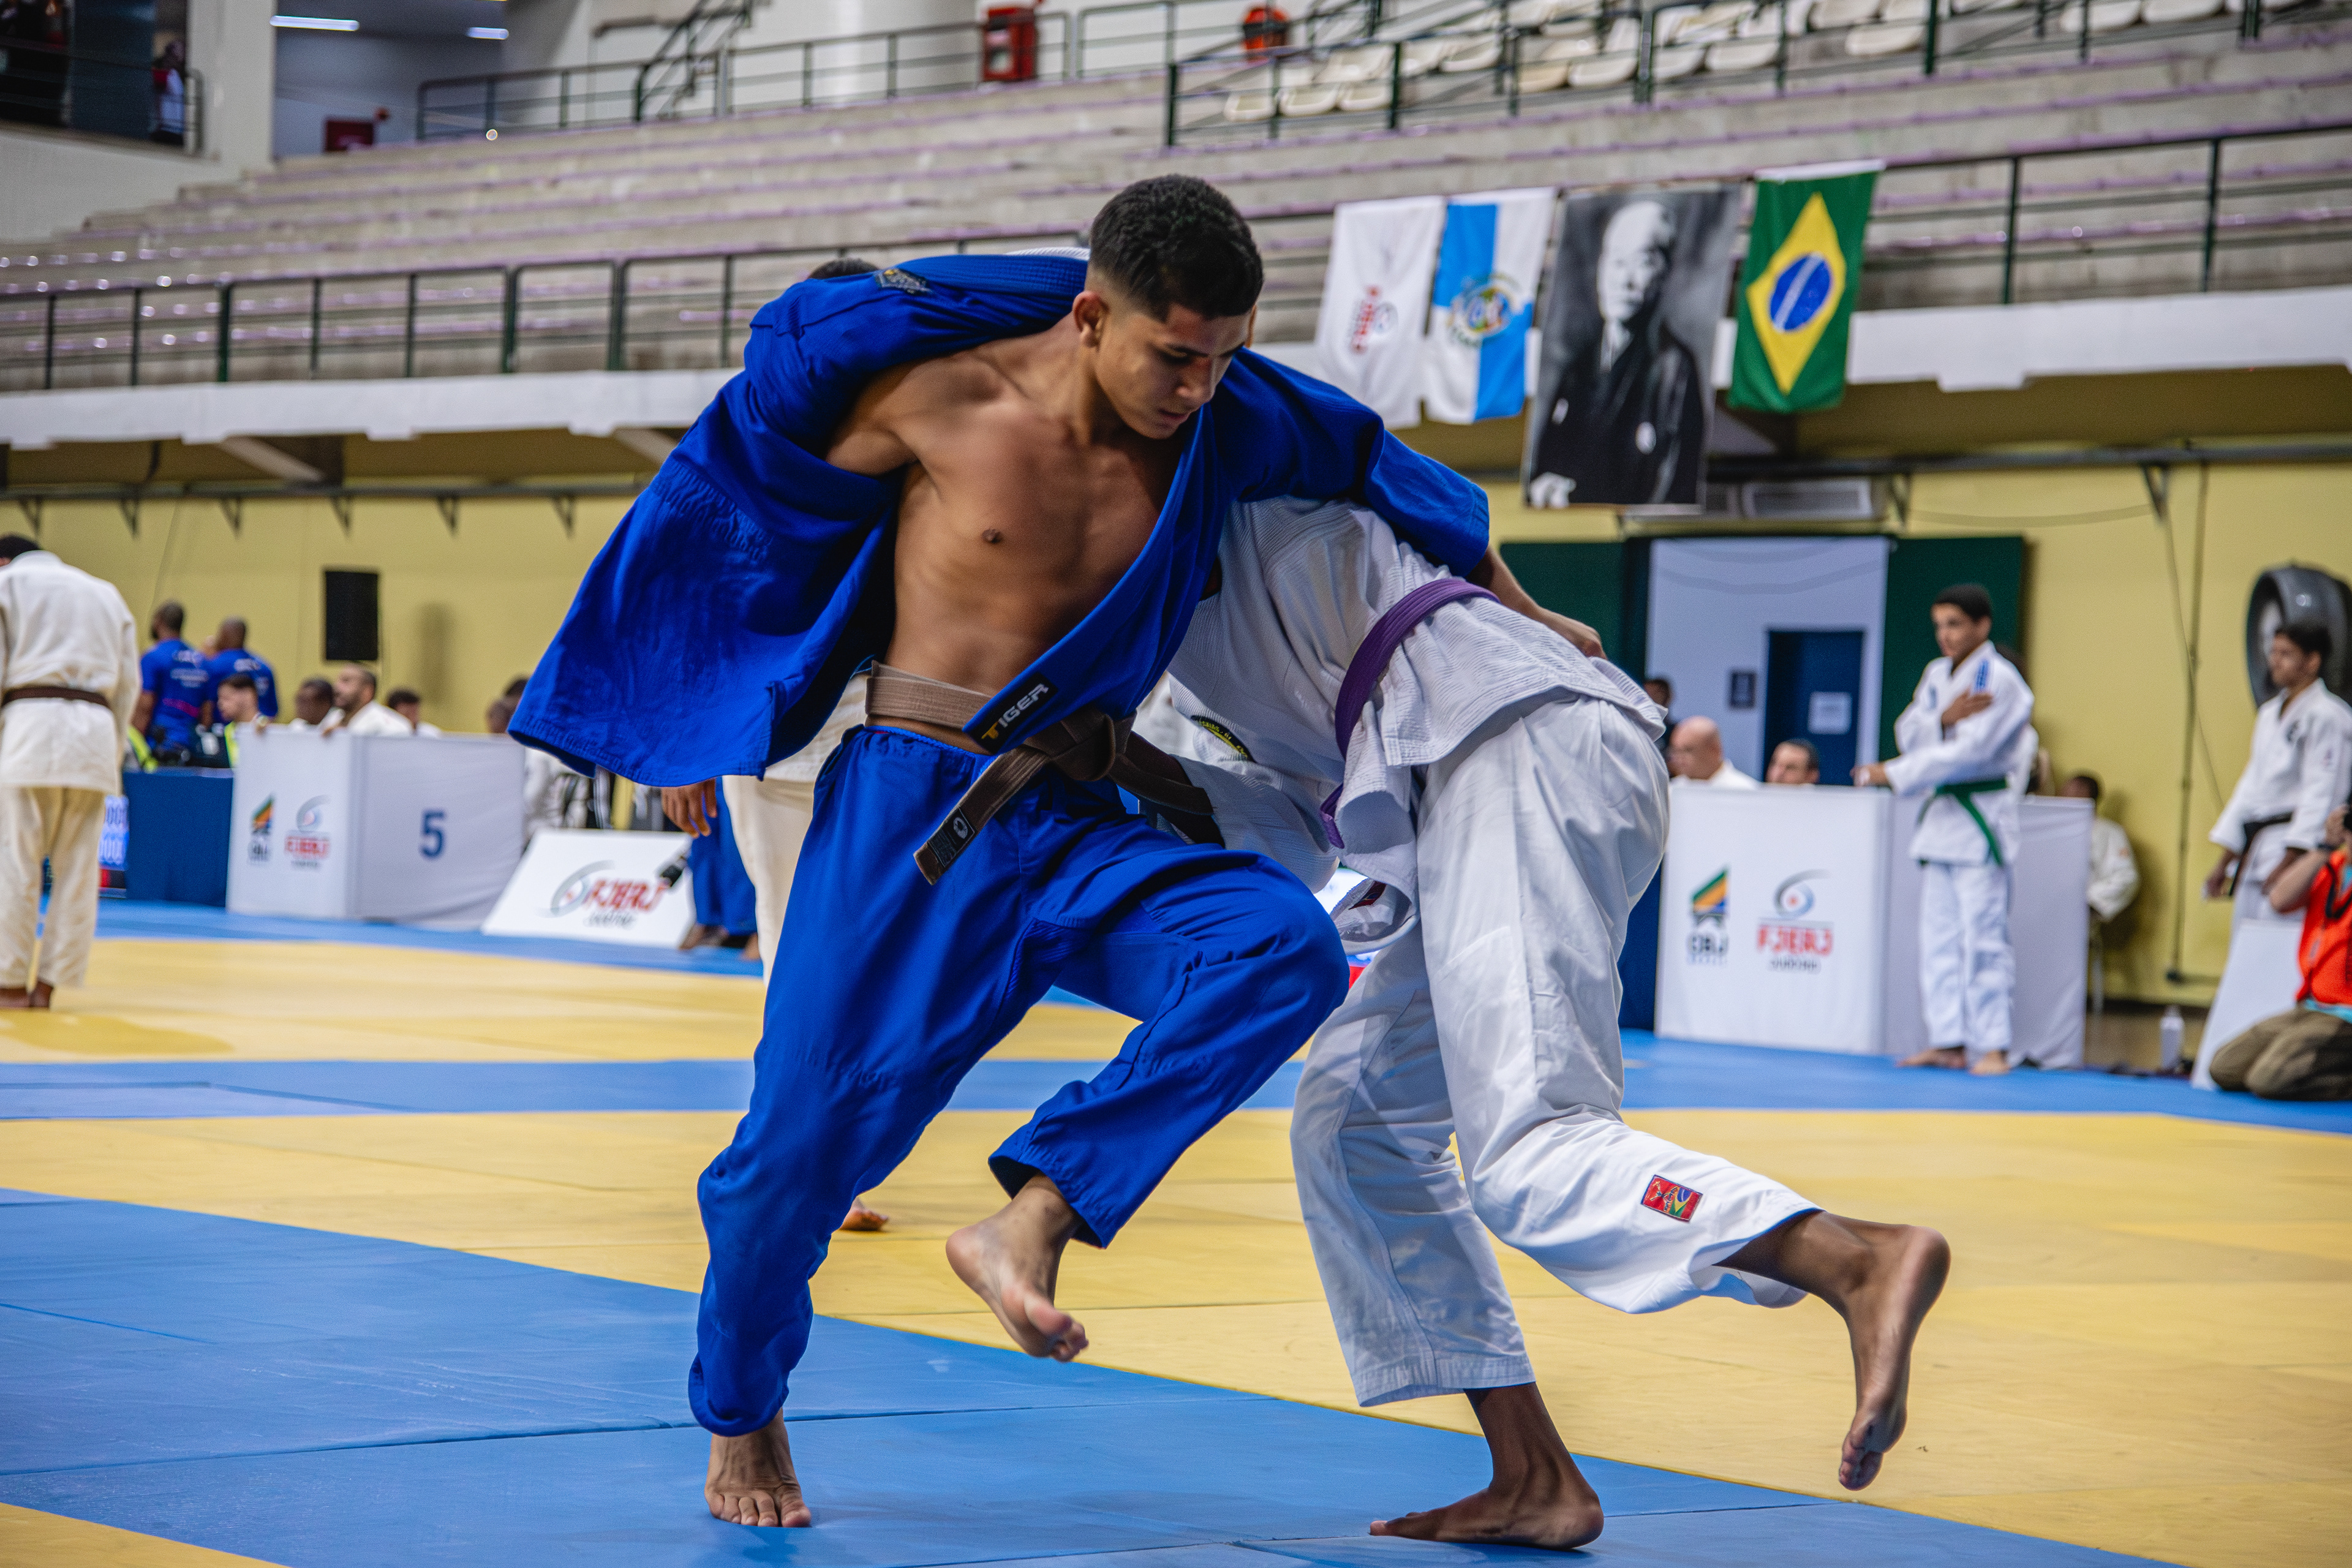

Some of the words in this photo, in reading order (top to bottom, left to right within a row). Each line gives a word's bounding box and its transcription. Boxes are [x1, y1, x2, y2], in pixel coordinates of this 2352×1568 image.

[981, 683, 1049, 739] TIGER
[420, 810, 445, 859] 5
[1757, 924, 1833, 956] FJERJ
